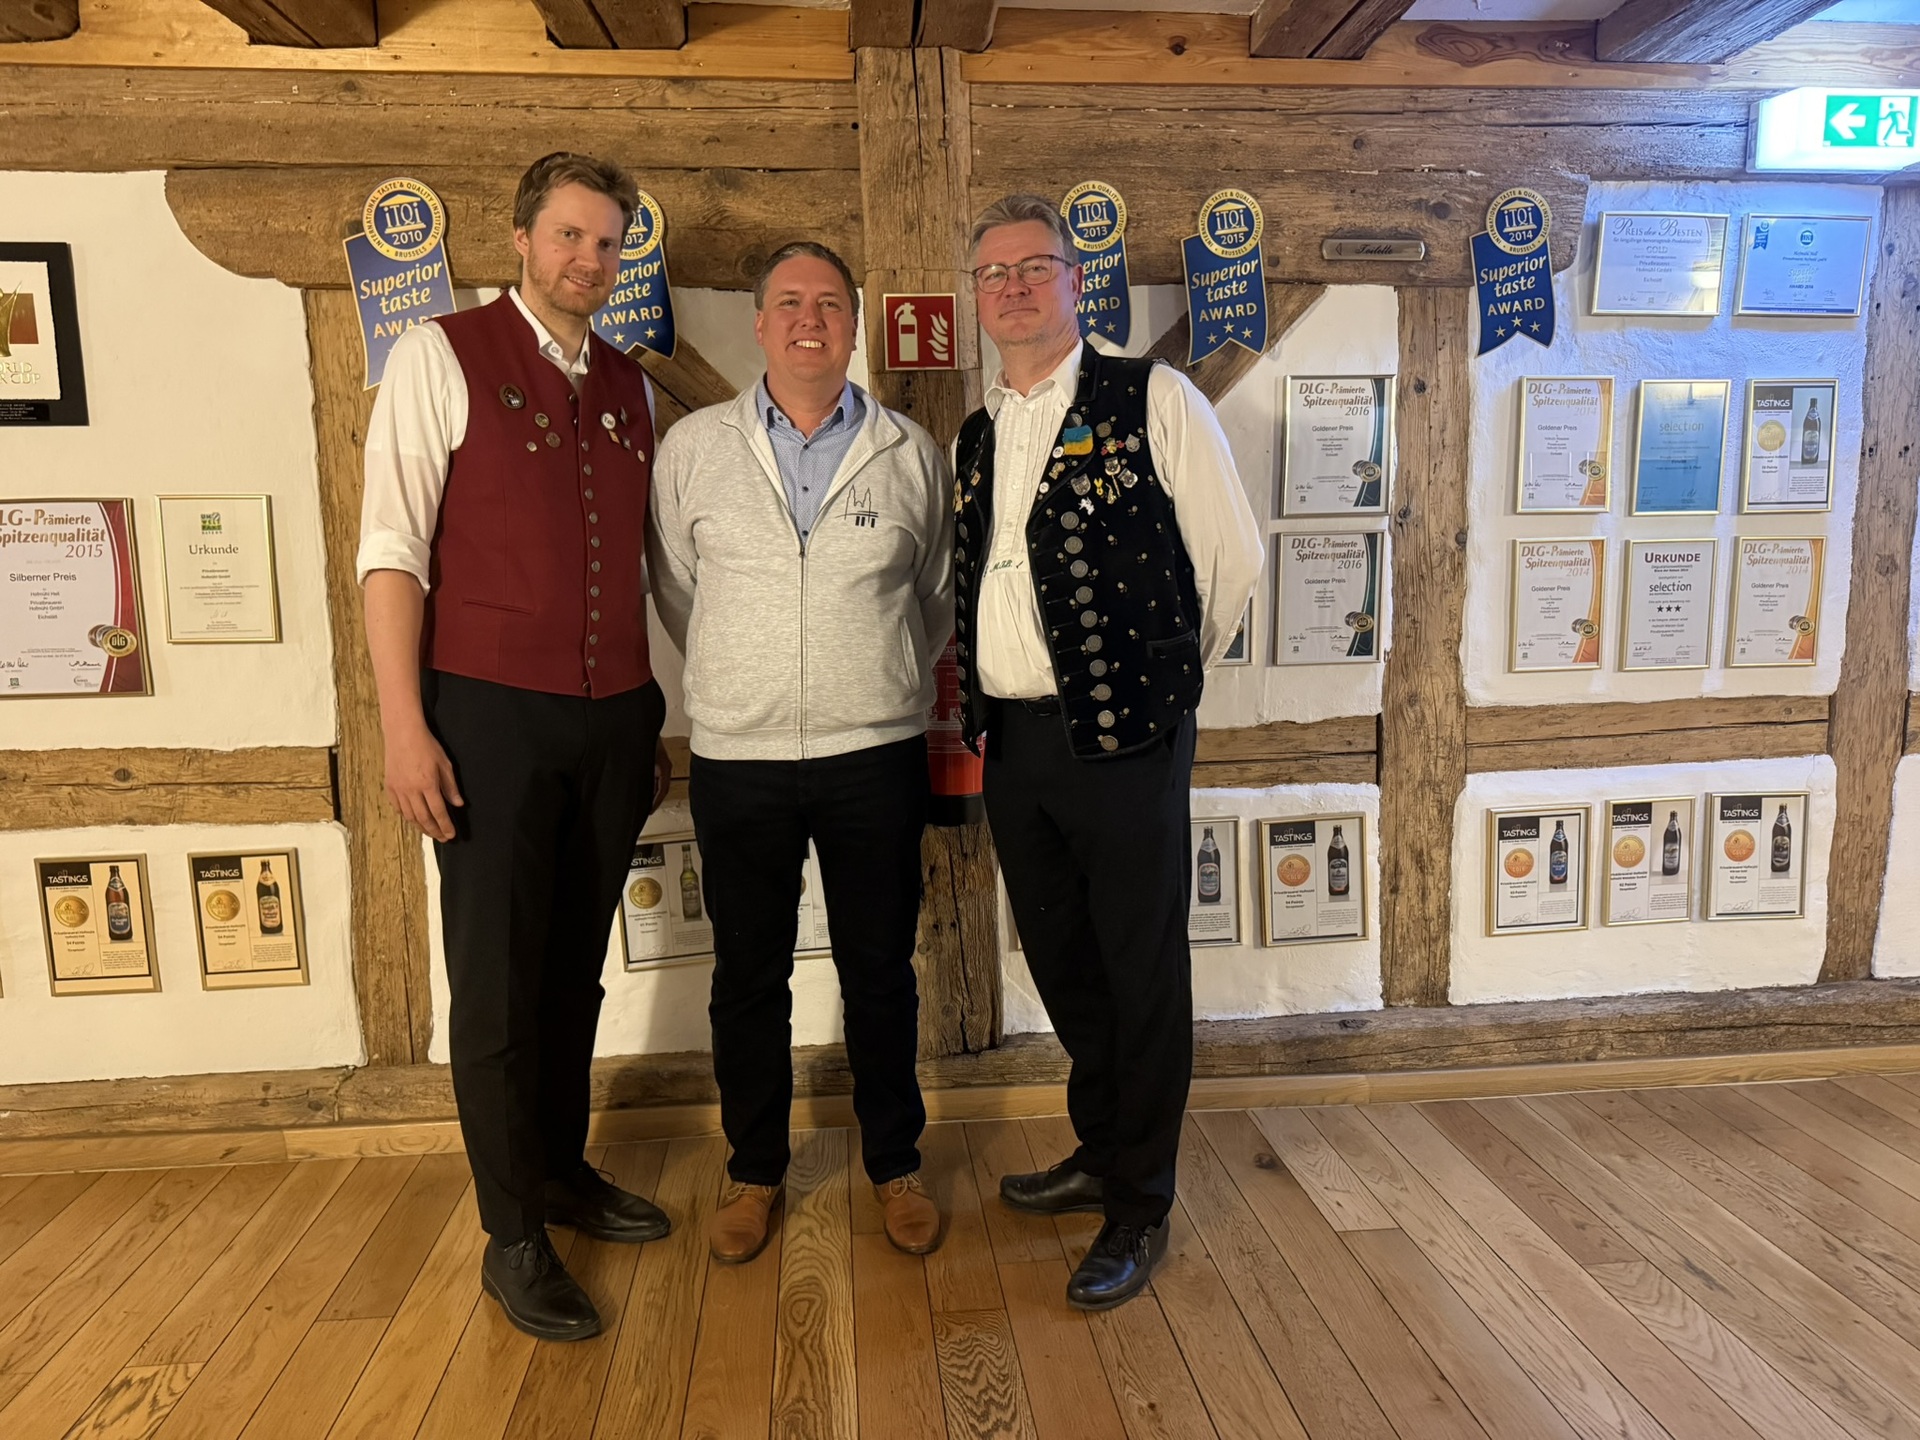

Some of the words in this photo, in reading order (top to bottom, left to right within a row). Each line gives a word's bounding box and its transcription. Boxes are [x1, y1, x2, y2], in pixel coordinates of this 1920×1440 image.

[366, 195, 384, 248] INTERNATIONAL
[377, 182, 396, 196] TASTE
[406, 183, 435, 203] QUALITY
[431, 201, 441, 240] INSTITUTE
[1073, 184, 1091, 196] TASTE
[1097, 184, 1119, 202] QUALITY
[1115, 202, 1125, 235] INSTITUTE
[1201, 203, 1214, 247] INTERNATIONAL
[1212, 191, 1228, 203] TASTE
[1235, 192, 1256, 209] QUALITY
[1252, 210, 1261, 242] INSTITUTE
[1488, 201, 1502, 245] INTERNATIONAL
[1500, 190, 1517, 201] TASTE
[1524, 191, 1545, 208] QUALITY
[1541, 207, 1550, 239] INSTITUTE
[652, 209, 661, 241] INSTITUTE
[1644, 227, 1657, 236] der
[392, 230, 423, 245] 2010
[1083, 226, 1108, 239] 2013
[1220, 233, 1245, 245] 2015
[1509, 230, 1534, 243] 2014
[624, 233, 645, 246] 012
[1083, 240, 1111, 250] BRUSSELS
[395, 246, 427, 258] BRUSSELS
[1221, 246, 1248, 256] BRUSSELS
[1509, 243, 1536, 253] BRUSSELS
[1646, 246, 1668, 254] GOLD
[1083, 252, 1122, 275] erior
[1479, 255, 1547, 285] Superior
[615, 260, 661, 287] erior
[1191, 258, 1259, 289] Superior
[360, 261, 443, 300] Superior
[1494, 275, 1536, 298] taste
[1205, 281, 1248, 303] taste
[380, 287, 432, 316] taste
[1075, 296, 1121, 315] WARD
[1487, 297, 1546, 317] AWARD
[601, 305, 663, 327] AWARD
[1199, 302, 1257, 323] AWARD
[11, 373, 41, 385] CUP
[1303, 395, 1373, 409] Spitzenqualität
[1532, 394, 1598, 408] Spitzenqualität
[1756, 399, 1791, 407] TASTINGS
[1345, 406, 1370, 417] 2016
[1574, 407, 1597, 416] 2014
[1659, 421, 1704, 432] selection
[0, 509, 92, 526] LG-Prämierte
[65, 543, 104, 558] 2015
[189, 544, 239, 555] Urkunde
[1295, 549, 1365, 563] Spitzenqualität
[1337, 560, 1362, 570] 2016
[1525, 557, 1591, 570] Spitzenqualität
[1746, 554, 1811, 567] Spitzenqualität
[1566, 567, 1590, 577] 2014
[1786, 565, 1809, 575] 2014
[9, 573, 51, 582] Silberner
[53, 572, 77, 581] Preis
[1649, 580, 1692, 593] selection
[1612, 813, 1649, 822] TASTINGS
[1722, 809, 1759, 818] TASTINGS
[1273, 832, 1313, 843] TASTINGS
[1502, 828, 1537, 838] TASTINGS
[630, 856, 663, 867] STINGS
[47, 875, 89, 884] TASTINGS
[199, 868, 240, 878] TASTINGS
